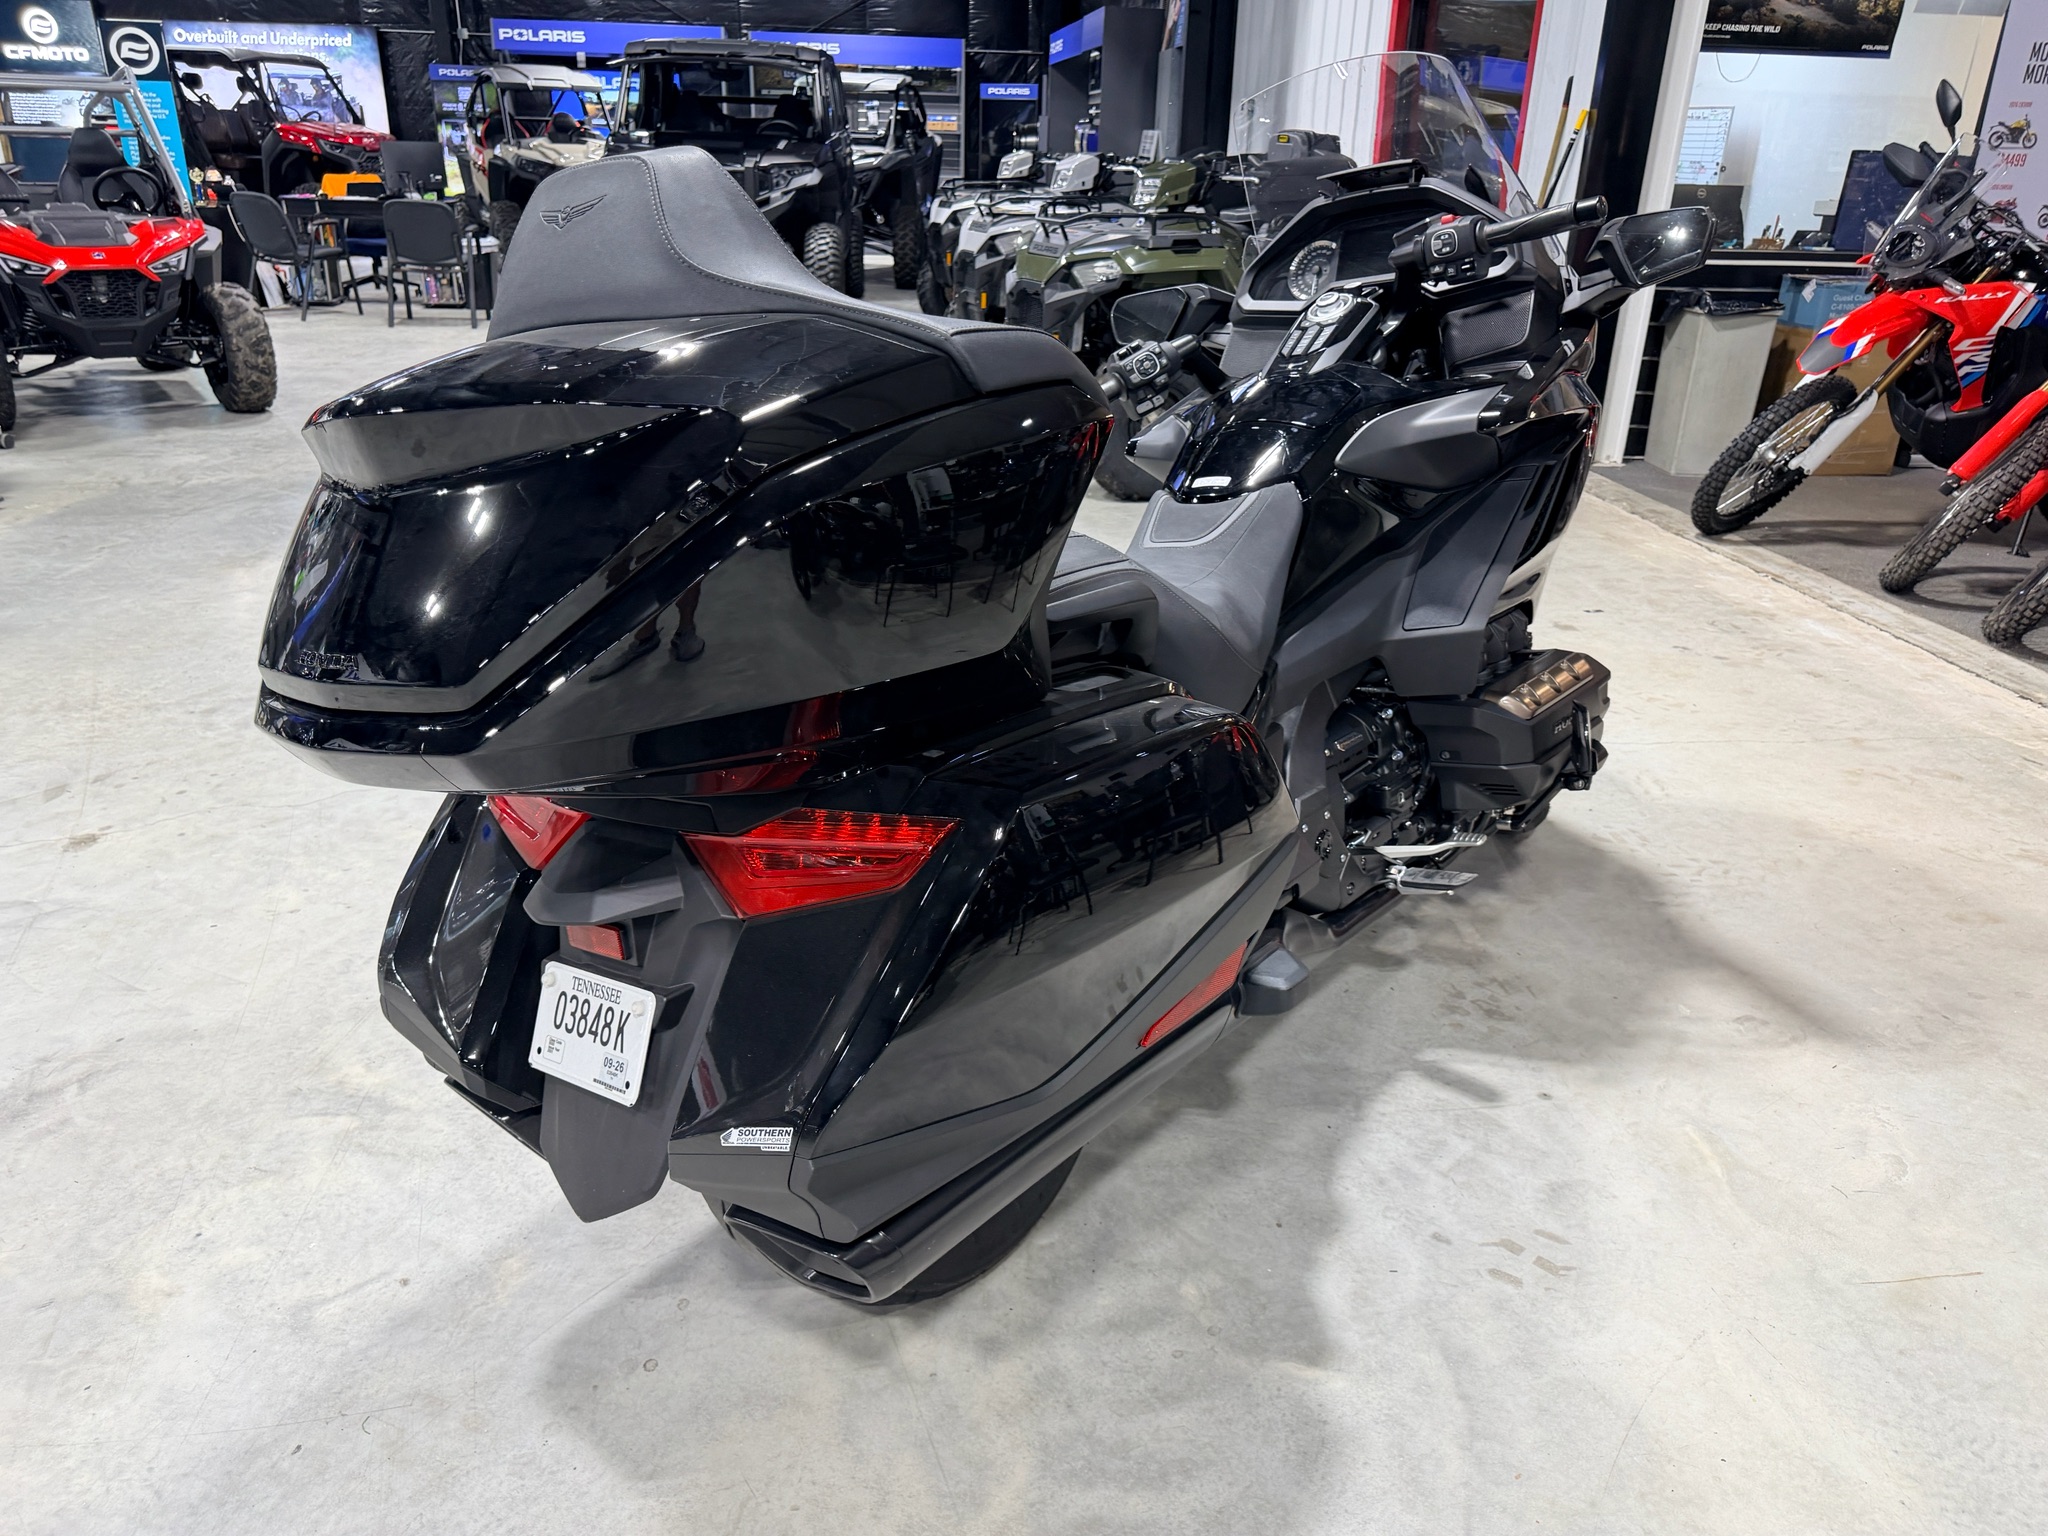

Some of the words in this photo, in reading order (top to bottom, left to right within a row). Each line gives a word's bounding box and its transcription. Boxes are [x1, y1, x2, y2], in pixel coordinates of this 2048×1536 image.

[498, 28, 586, 43] POLARIS
[1704, 23, 1722, 31] KEEP
[1722, 24, 1749, 32] CHASING
[1764, 25, 1781, 33] WILD
[173, 28, 238, 44] Overbuilt
[241, 31, 267, 45] and
[270, 33, 352, 49] Underpriced
[4, 45, 90, 61] CFMOTO
[438, 68, 474, 77] POLA
[987, 87, 1031, 96] POLARIS
[1934, 291, 2012, 304] RALLY
[572, 976, 622, 1005] TENNESSEE
[553, 991, 631, 1054] 03848K
[603, 1056, 625, 1073] 09-26
[737, 1128, 792, 1137] SOUTHERN
